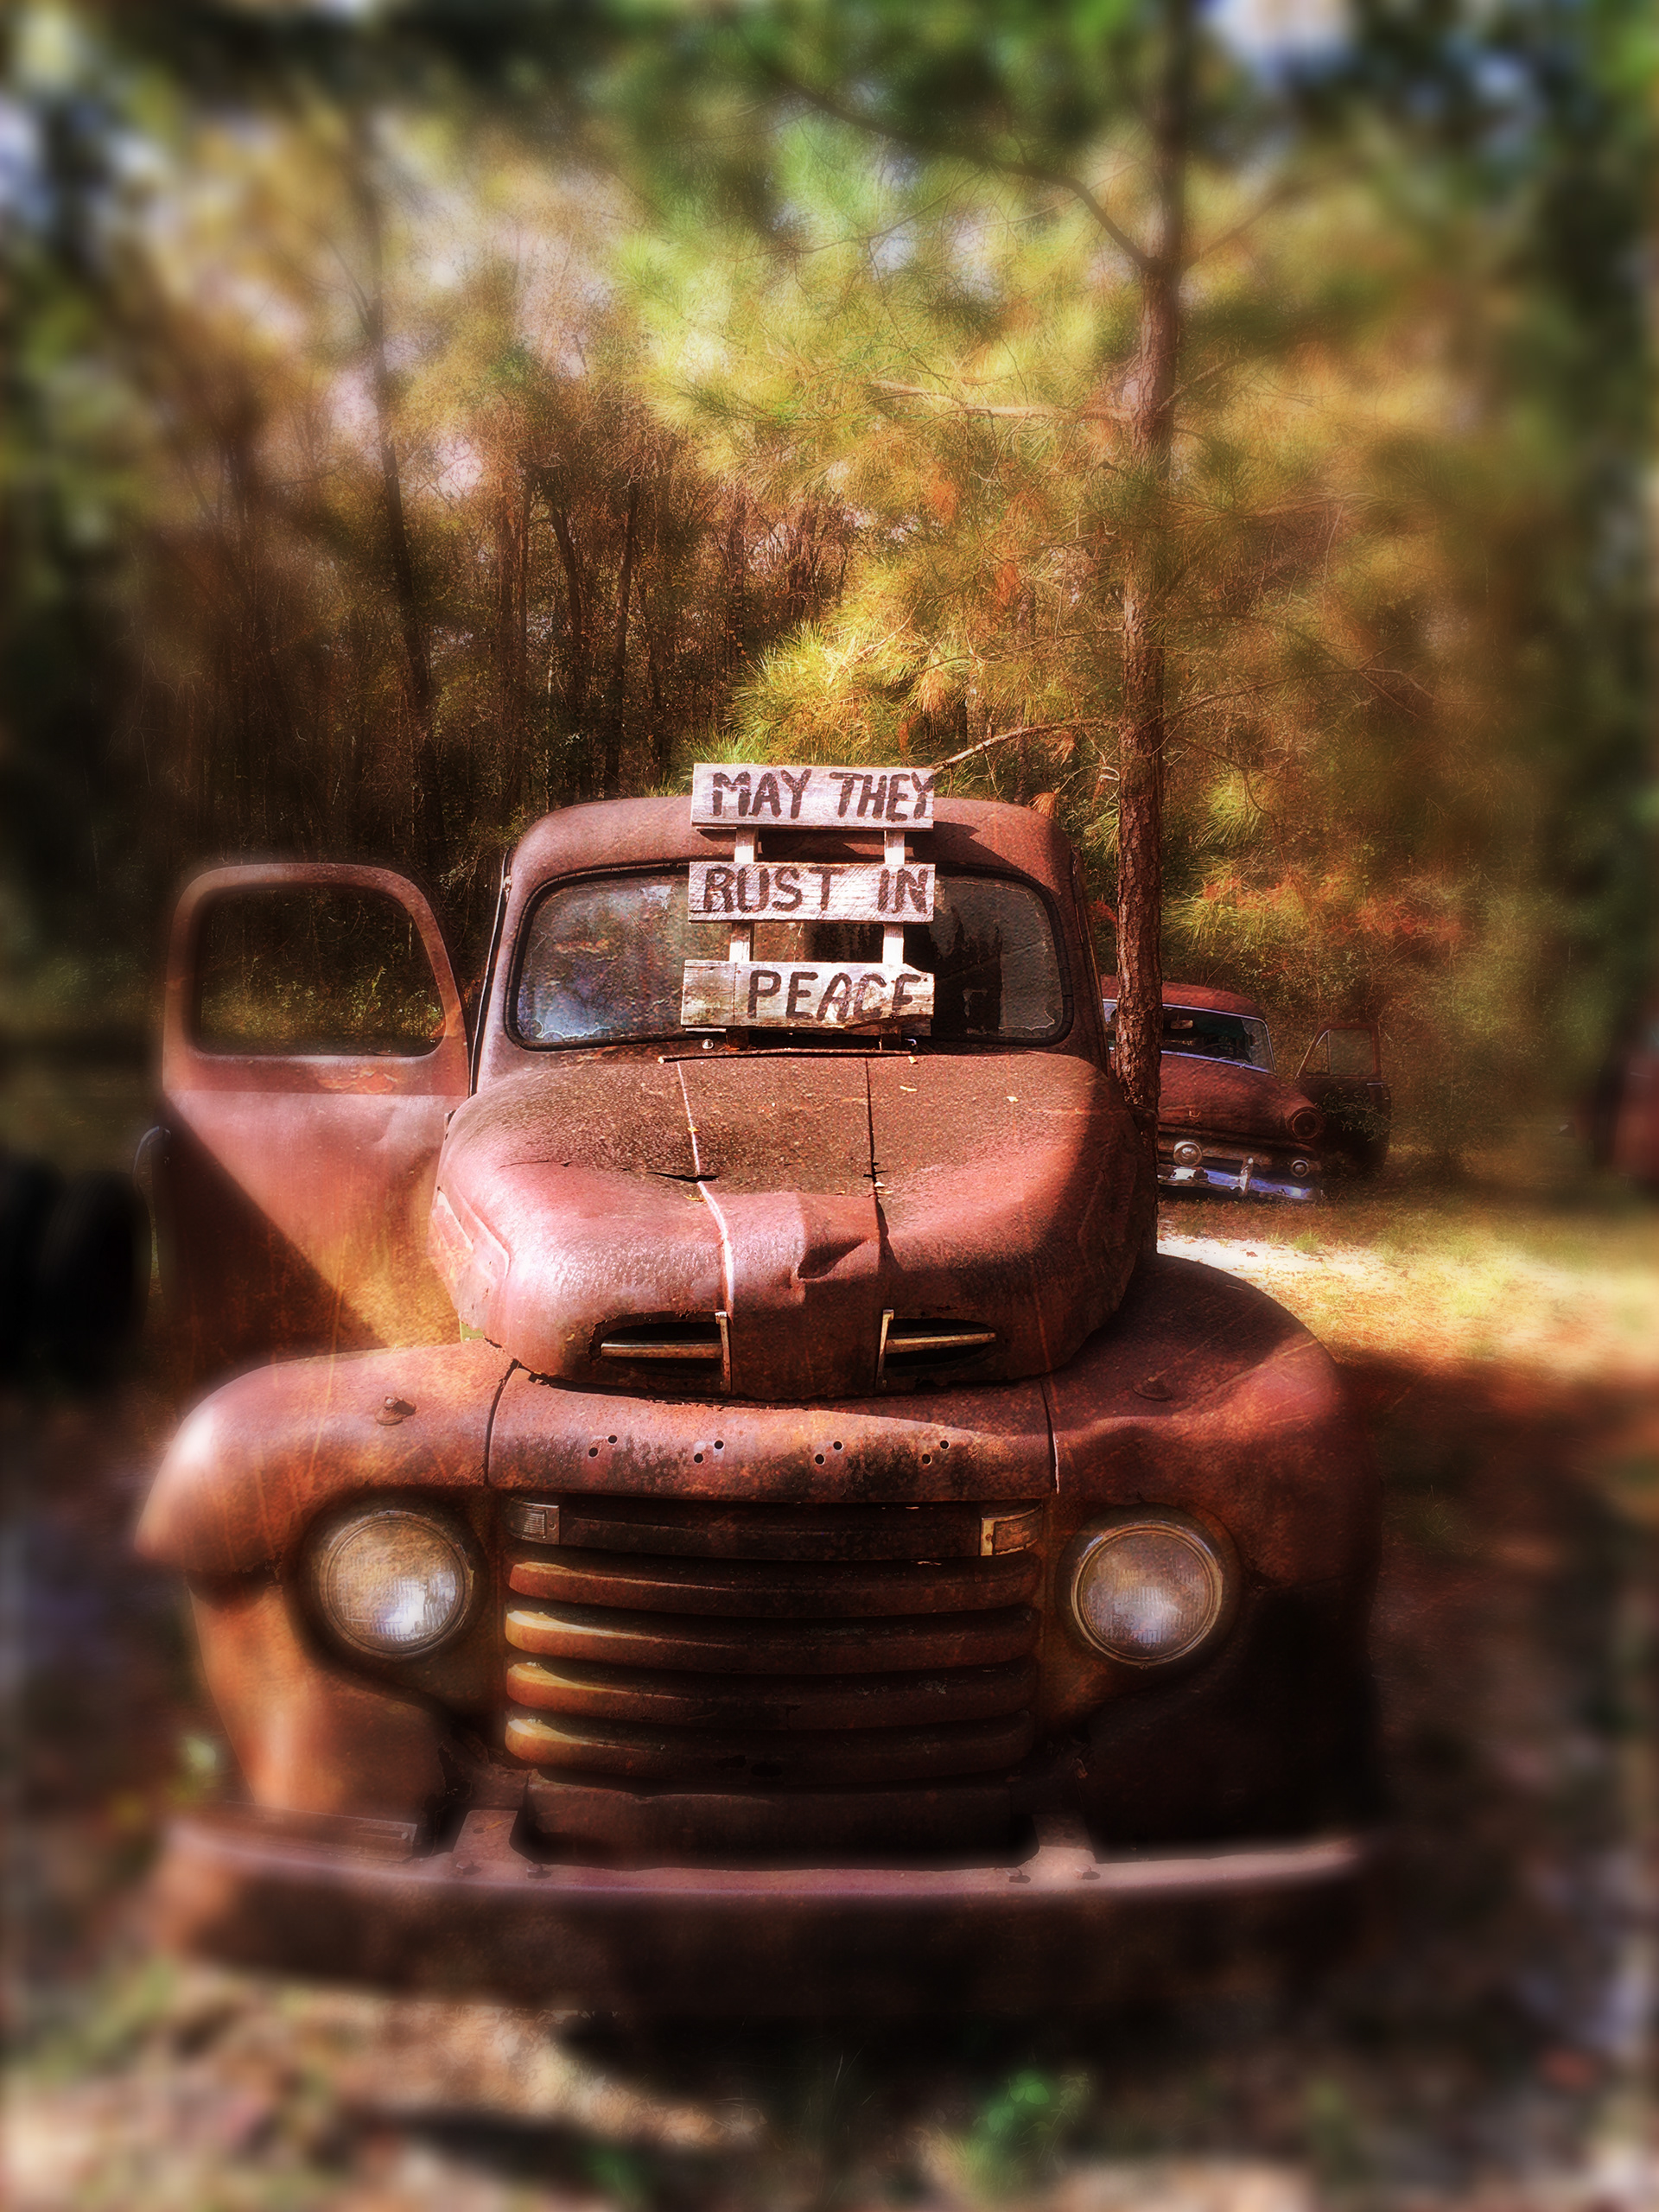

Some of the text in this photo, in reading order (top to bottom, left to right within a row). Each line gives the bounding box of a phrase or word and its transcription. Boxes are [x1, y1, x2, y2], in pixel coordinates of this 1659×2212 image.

[712, 768, 934, 822] MAY THEY
[702, 866, 928, 913] RUST IN
[747, 969, 922, 1020] PEACE
